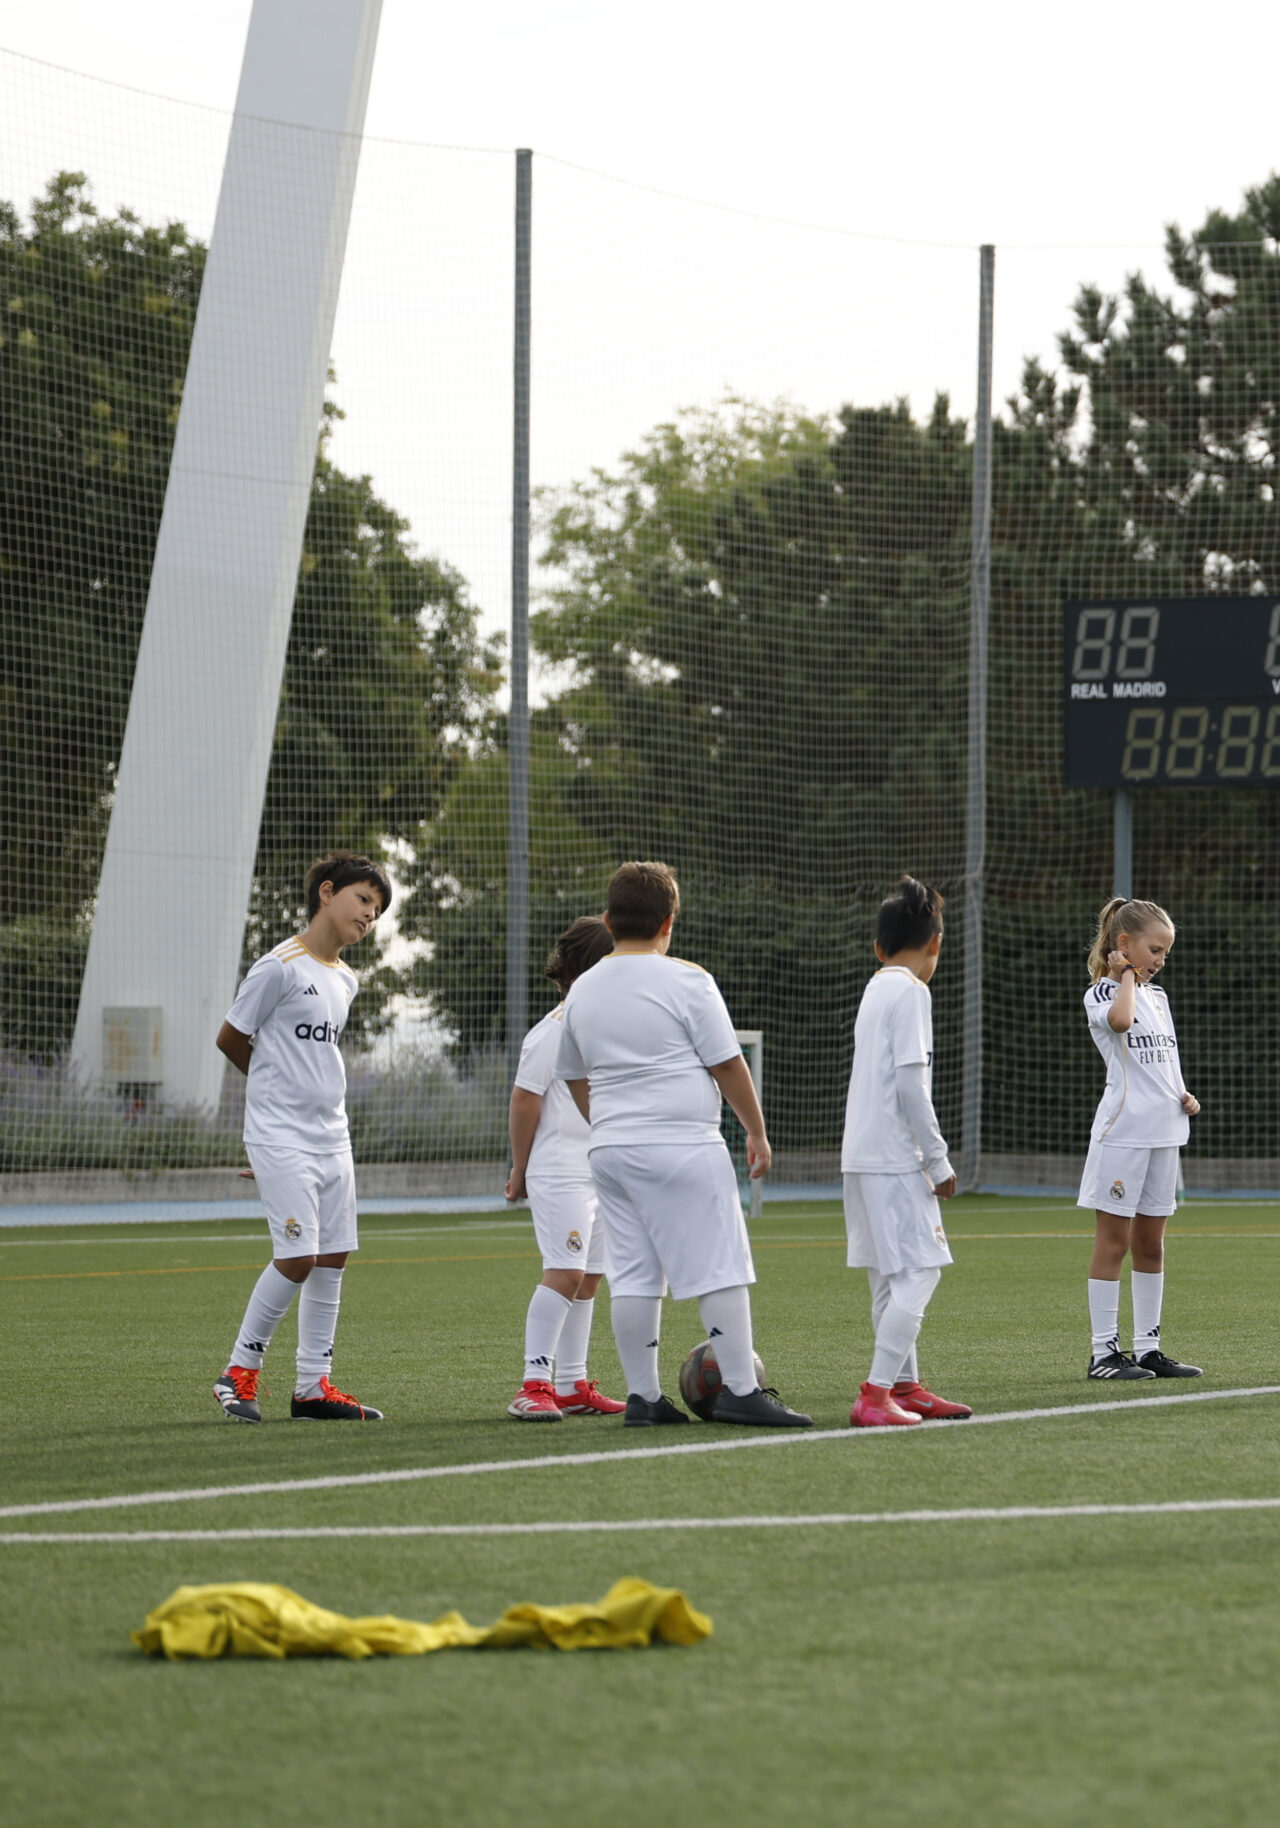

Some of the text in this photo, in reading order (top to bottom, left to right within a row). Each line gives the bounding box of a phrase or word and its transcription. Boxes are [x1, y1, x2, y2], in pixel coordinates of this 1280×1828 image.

[1071, 681, 1167, 699] REAL MADRID
[1140, 1050, 1154, 1064] FLY
